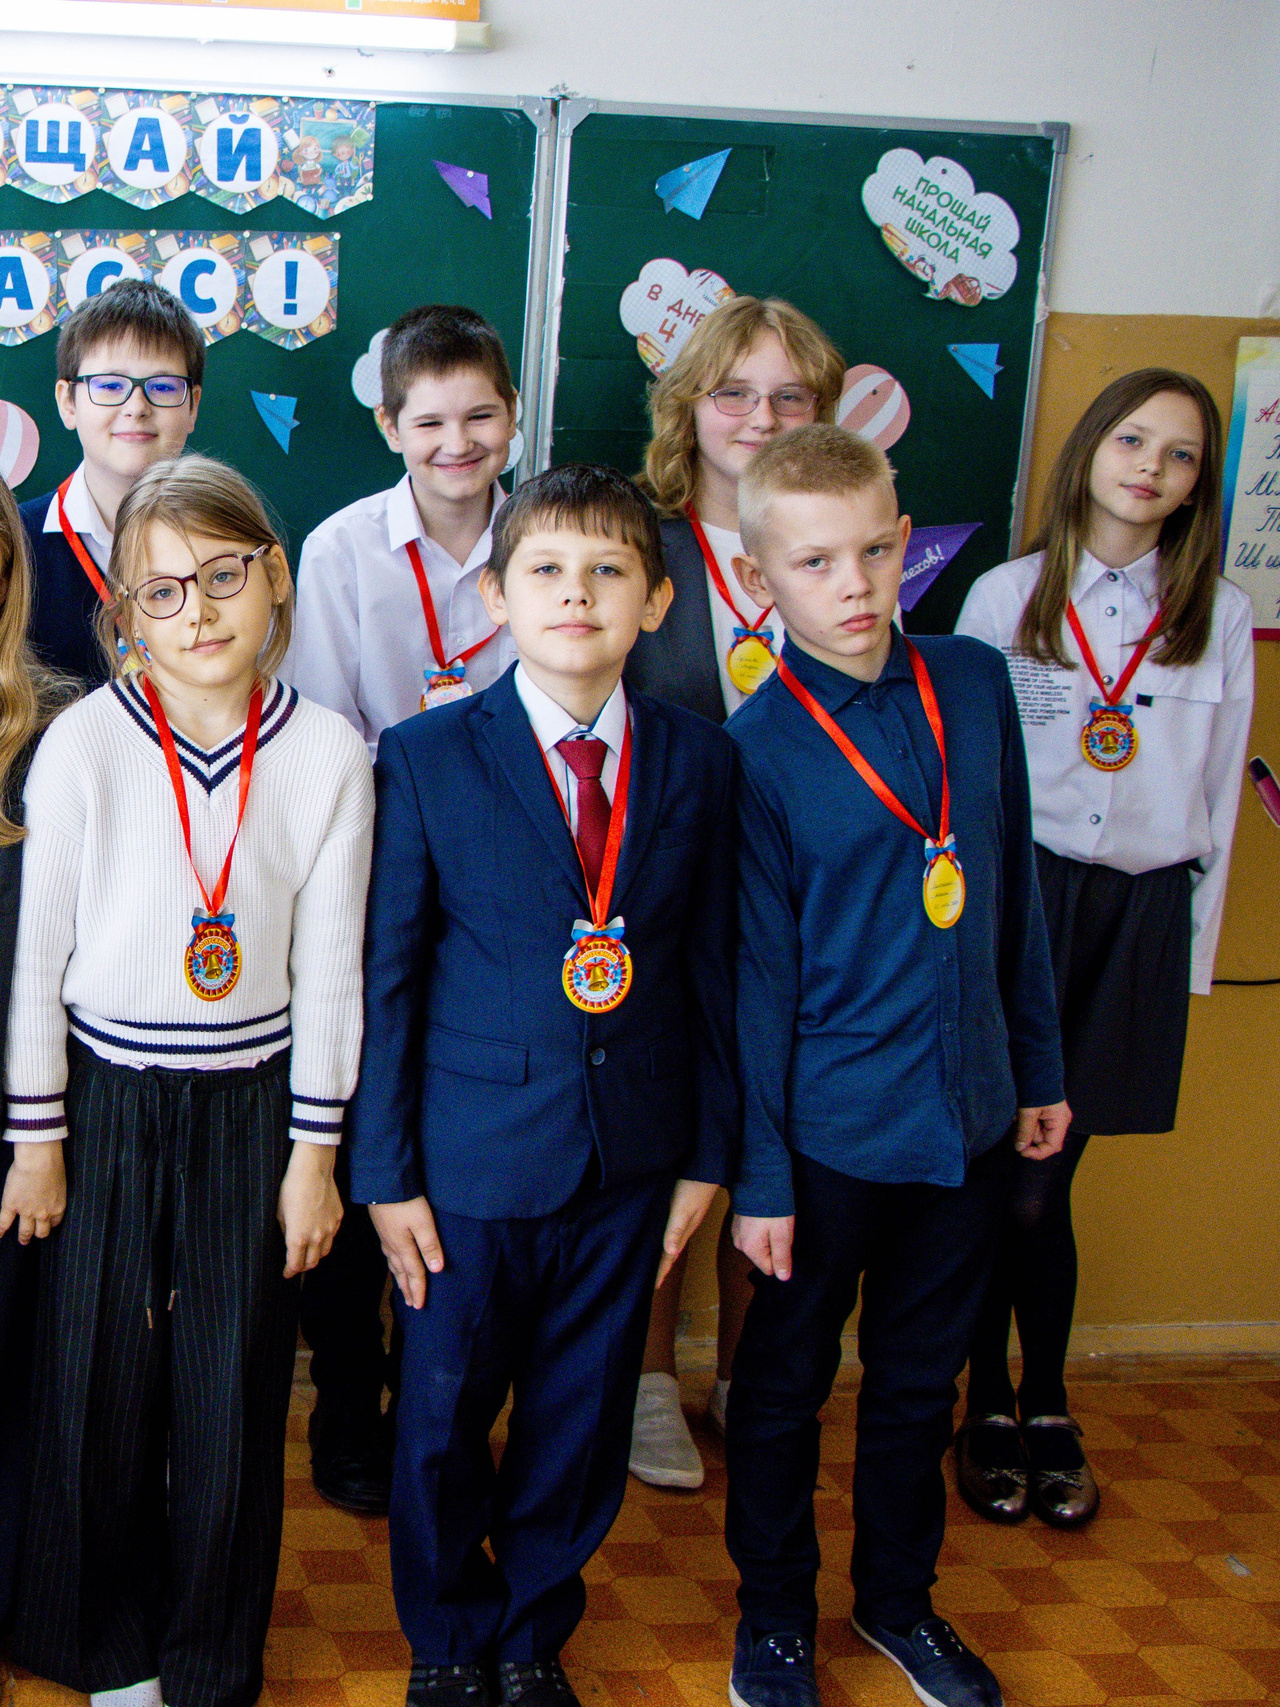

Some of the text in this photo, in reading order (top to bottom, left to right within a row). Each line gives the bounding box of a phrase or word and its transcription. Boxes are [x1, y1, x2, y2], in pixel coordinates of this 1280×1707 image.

[893, 185, 993, 260] НАЧАЛЬНАЯ
[915, 176, 992, 234] ПРОЩАЙ
[904, 217, 960, 264] ШКОЛА
[647, 284, 663, 301] В
[658, 318, 678, 344] 4
[900, 543, 945, 585] пехов!
